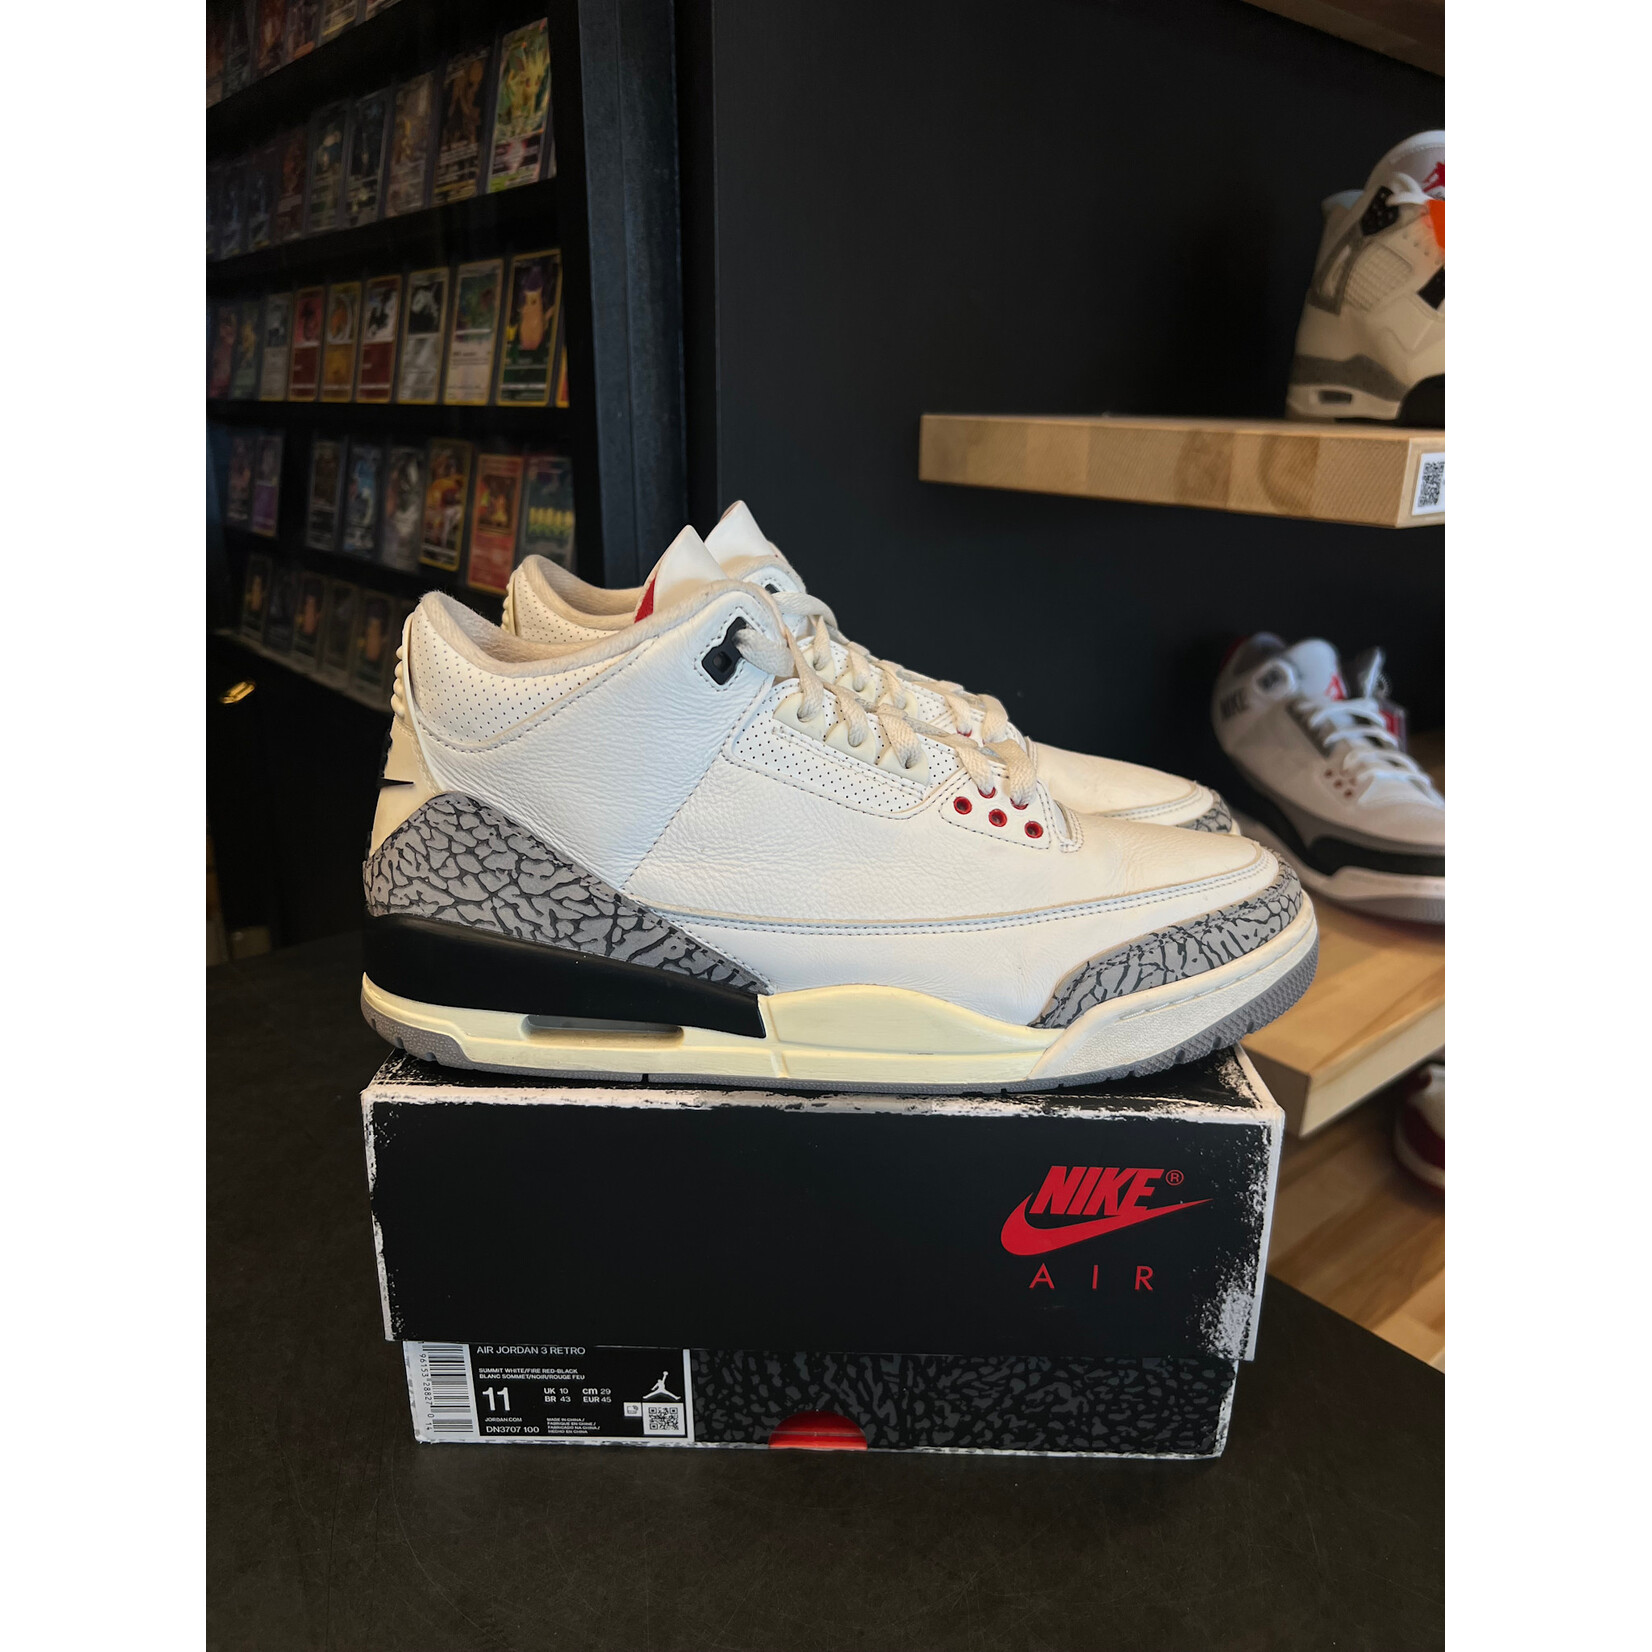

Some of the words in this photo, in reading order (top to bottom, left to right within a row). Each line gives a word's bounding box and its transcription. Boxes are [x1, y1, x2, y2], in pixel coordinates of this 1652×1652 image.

[1029, 1263, 1153, 1290] AIR
[476, 1346, 494, 1354] AIR
[496, 1346, 539, 1354] JORDAN
[540, 1347, 548, 1355] 3
[550, 1347, 586, 1355] RETRO
[419, 1353, 429, 1377] 96153
[482, 1387, 510, 1411] 11
